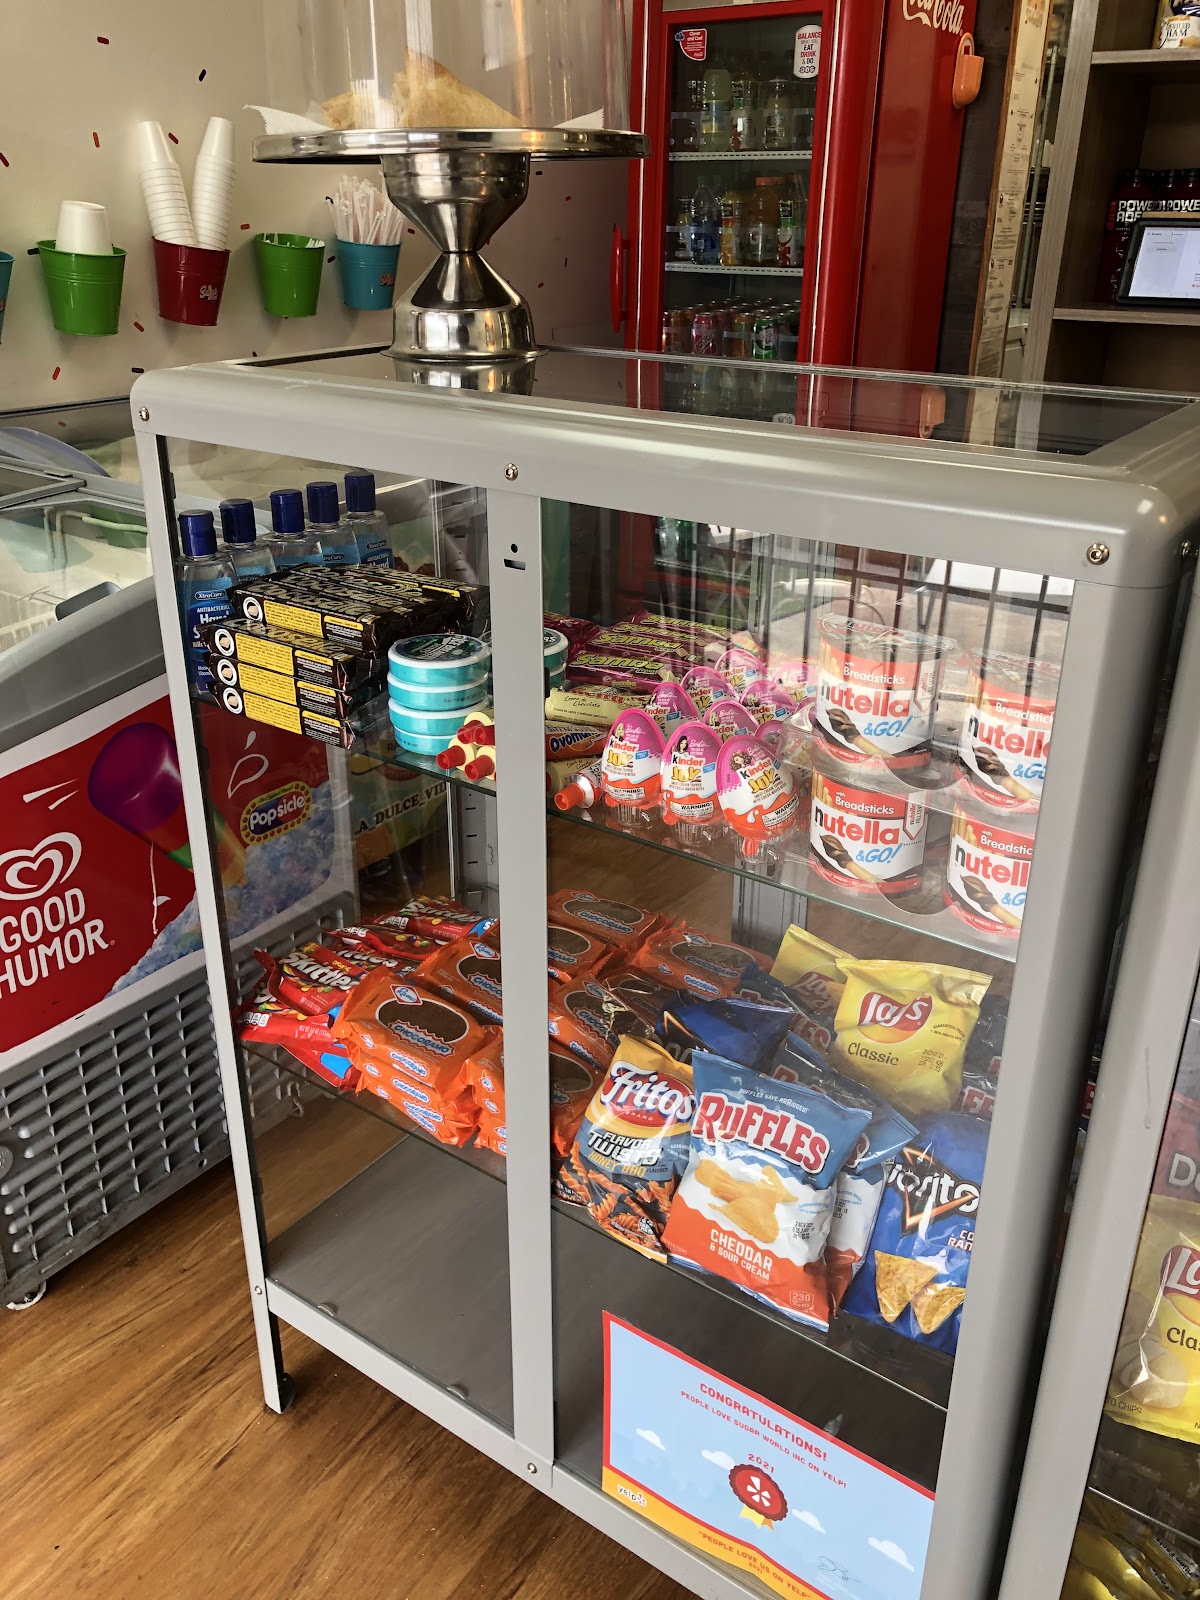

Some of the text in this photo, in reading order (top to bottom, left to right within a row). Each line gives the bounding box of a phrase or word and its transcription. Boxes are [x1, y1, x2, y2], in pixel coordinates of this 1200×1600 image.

[797, 31, 822, 40] BALANCE
[1166, 29, 1188, 37] HAM
[803, 43, 813, 51] EAT
[596, 633, 683, 650] Samba
[572, 653, 666, 671] Samba
[843, 665, 906, 685] Breadsticks
[821, 678, 911, 718] nutella
[995, 702, 1054, 724] Breadstick
[863, 715, 914, 737] &GO!
[609, 739, 637, 752] kinder
[672, 754, 704, 767] kinder
[740, 759, 772, 780] kinder
[250, 795, 305, 830] Popsicle
[835, 796, 895, 815] Breadsticks
[814, 805, 900, 846] nutella
[981, 829, 993, 837] with
[856, 843, 903, 864] &GO!
[980, 835, 1033, 856] Breadstic
[954, 843, 1030, 888] nutell
[0, 888, 86, 954] GOOD
[579, 911, 631, 933] CHOCORAMO
[0, 918, 109, 1000] HUMOR
[686, 955, 739, 978] CHOCORAMO
[278, 952, 360, 990] Skittles
[473, 976, 502, 995] CHOCO
[469, 1001, 504, 1023] CHOCORAM
[861, 993, 929, 1027] Lay's
[394, 1024, 450, 1054] CHOCORAMO
[391, 1052, 427, 1076] CHOCORAMO
[847, 1042, 900, 1066] Classic
[394, 1079, 429, 1103] CHOCORAMO
[601, 1060, 695, 1121] Fritos
[624, 1110, 654, 1121] BRAND
[692, 1093, 829, 1172] RUFFLES
[588, 1150, 619, 1173] HONEY
[621, 1165, 647, 1178] BBQ
[888, 1164, 980, 1213] orito
[947, 1237, 973, 1252] RAN
[960, 1230, 975, 1240] CO
[710, 1228, 773, 1272] CHEDDAR
[717, 1246, 739, 1264] SOUR
[740, 1258, 770, 1282] CREAM
[792, 1291, 811, 1302] 230
[1118, 1400, 1143, 1414] CHIPS
[700, 1383, 828, 1461] CONGRATULATIONS!
[680, 1390, 847, 1489] PEOPLE LOVE SUGAR WORLD INC ON YELP!
[747, 1453, 775, 1474] 2021
[617, 1484, 638, 1502] yelp
[736, 1549, 758, 1564] LOVE
[759, 1561, 771, 1574] US
[773, 1572, 785, 1583] ON
[748, 1561, 763, 1574] 2021
